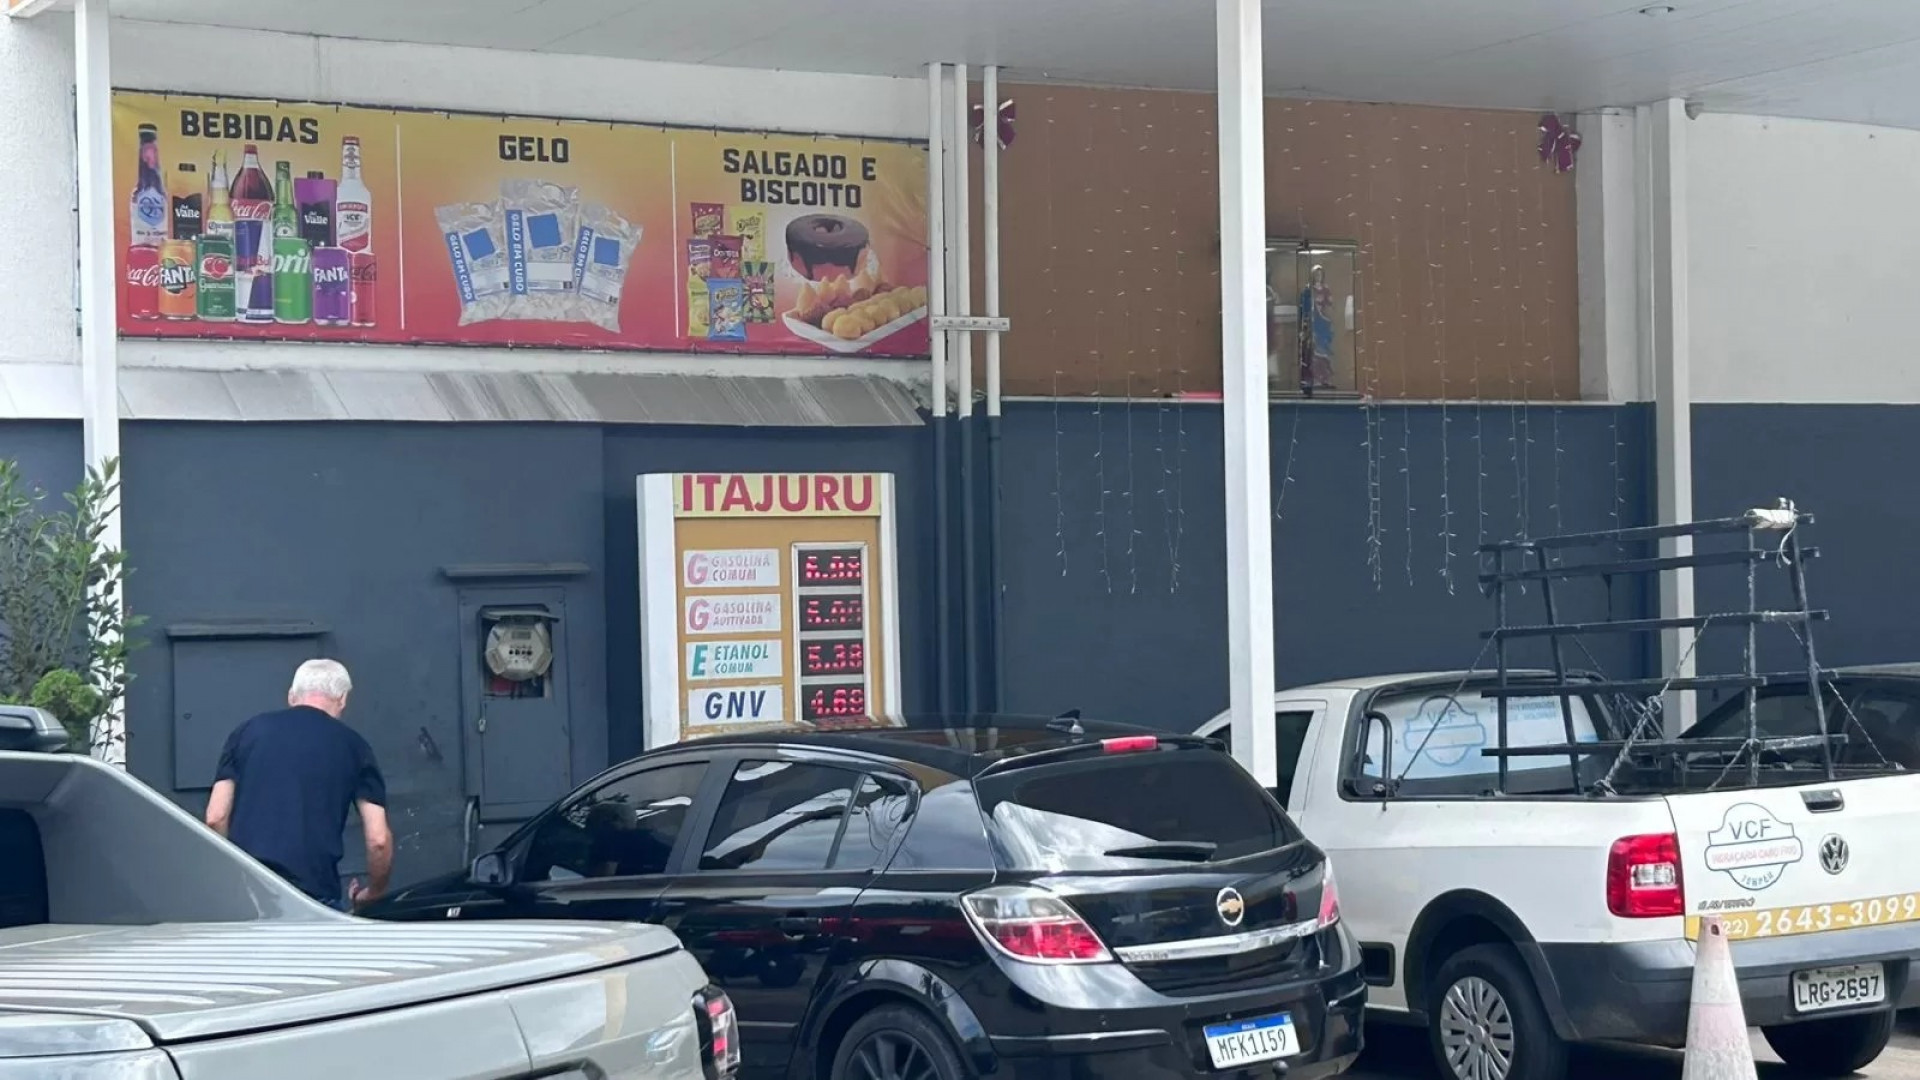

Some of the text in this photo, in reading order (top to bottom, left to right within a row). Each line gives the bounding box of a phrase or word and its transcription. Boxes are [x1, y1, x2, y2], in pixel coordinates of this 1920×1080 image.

[181, 110, 319, 144] BEBIDAS
[499, 134, 569, 163] GELO
[723, 148, 877, 181] SALGADO E
[741, 178, 862, 208] BISCOITO
[682, 475, 873, 512] ITAJURU
[688, 553, 709, 585] G
[711, 554, 770, 568] GASOLINA
[713, 569, 757, 582] COMUM
[690, 599, 709, 631] G
[713, 601, 772, 615] GASOLINA
[692, 645, 708, 676] E
[715, 644, 769, 661] ETANOL
[715, 662, 754, 674] COMUM
[705, 690, 766, 719] GNV
[1729, 819, 1772, 840] VCF
[1756, 894, 1917, 937] 2643-3099
